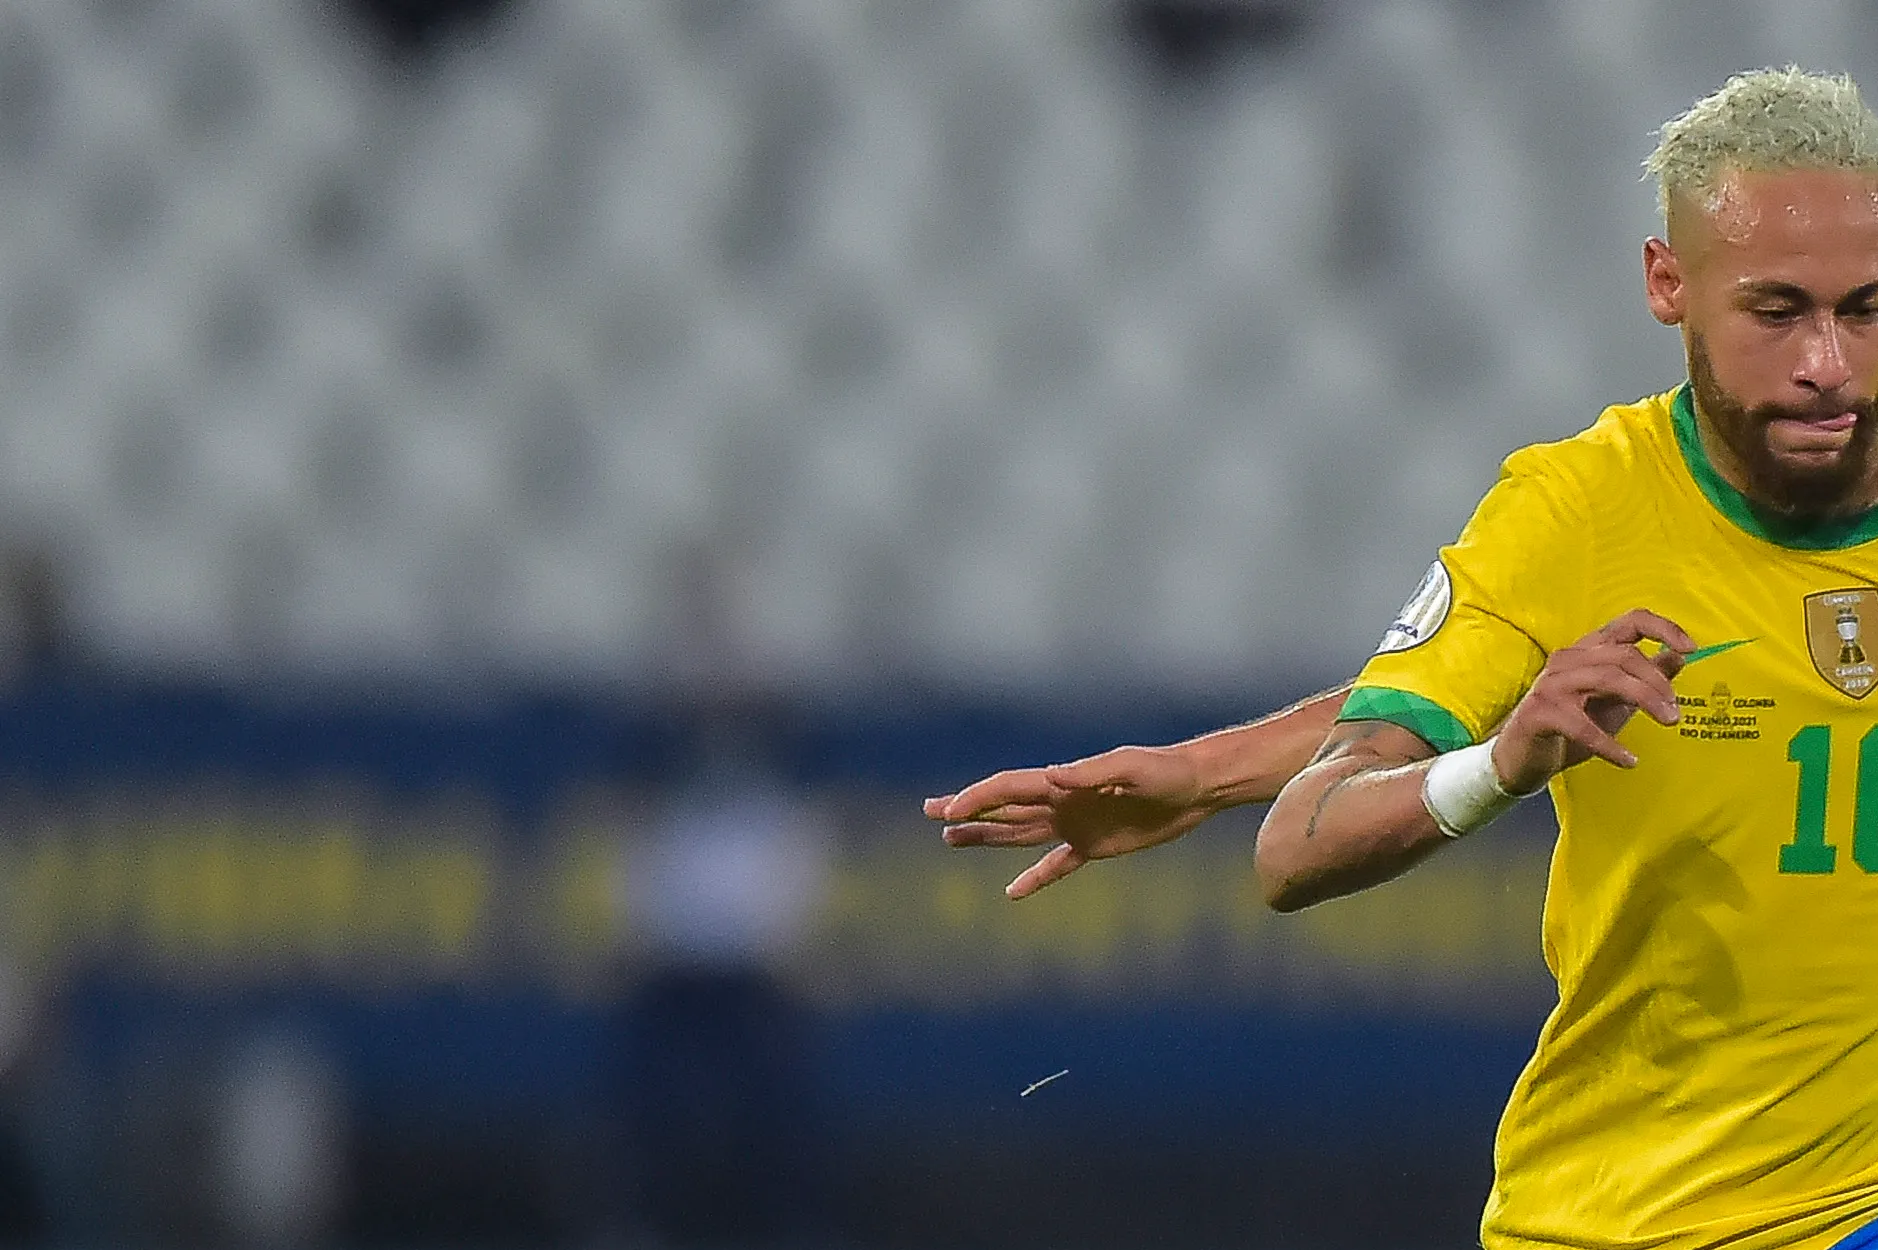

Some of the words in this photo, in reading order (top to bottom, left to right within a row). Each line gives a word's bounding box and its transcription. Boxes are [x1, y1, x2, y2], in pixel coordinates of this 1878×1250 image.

[1733, 698, 1776, 708] COLOMBIA
[1684, 715, 1697, 725] 23
[1699, 716, 1731, 726] JUNIO
[1732, 716, 1757, 726] 2021
[1680, 728, 1699, 738] RIO
[1700, 730, 1714, 740] DE
[1714, 730, 1760, 740] JANEIRO
